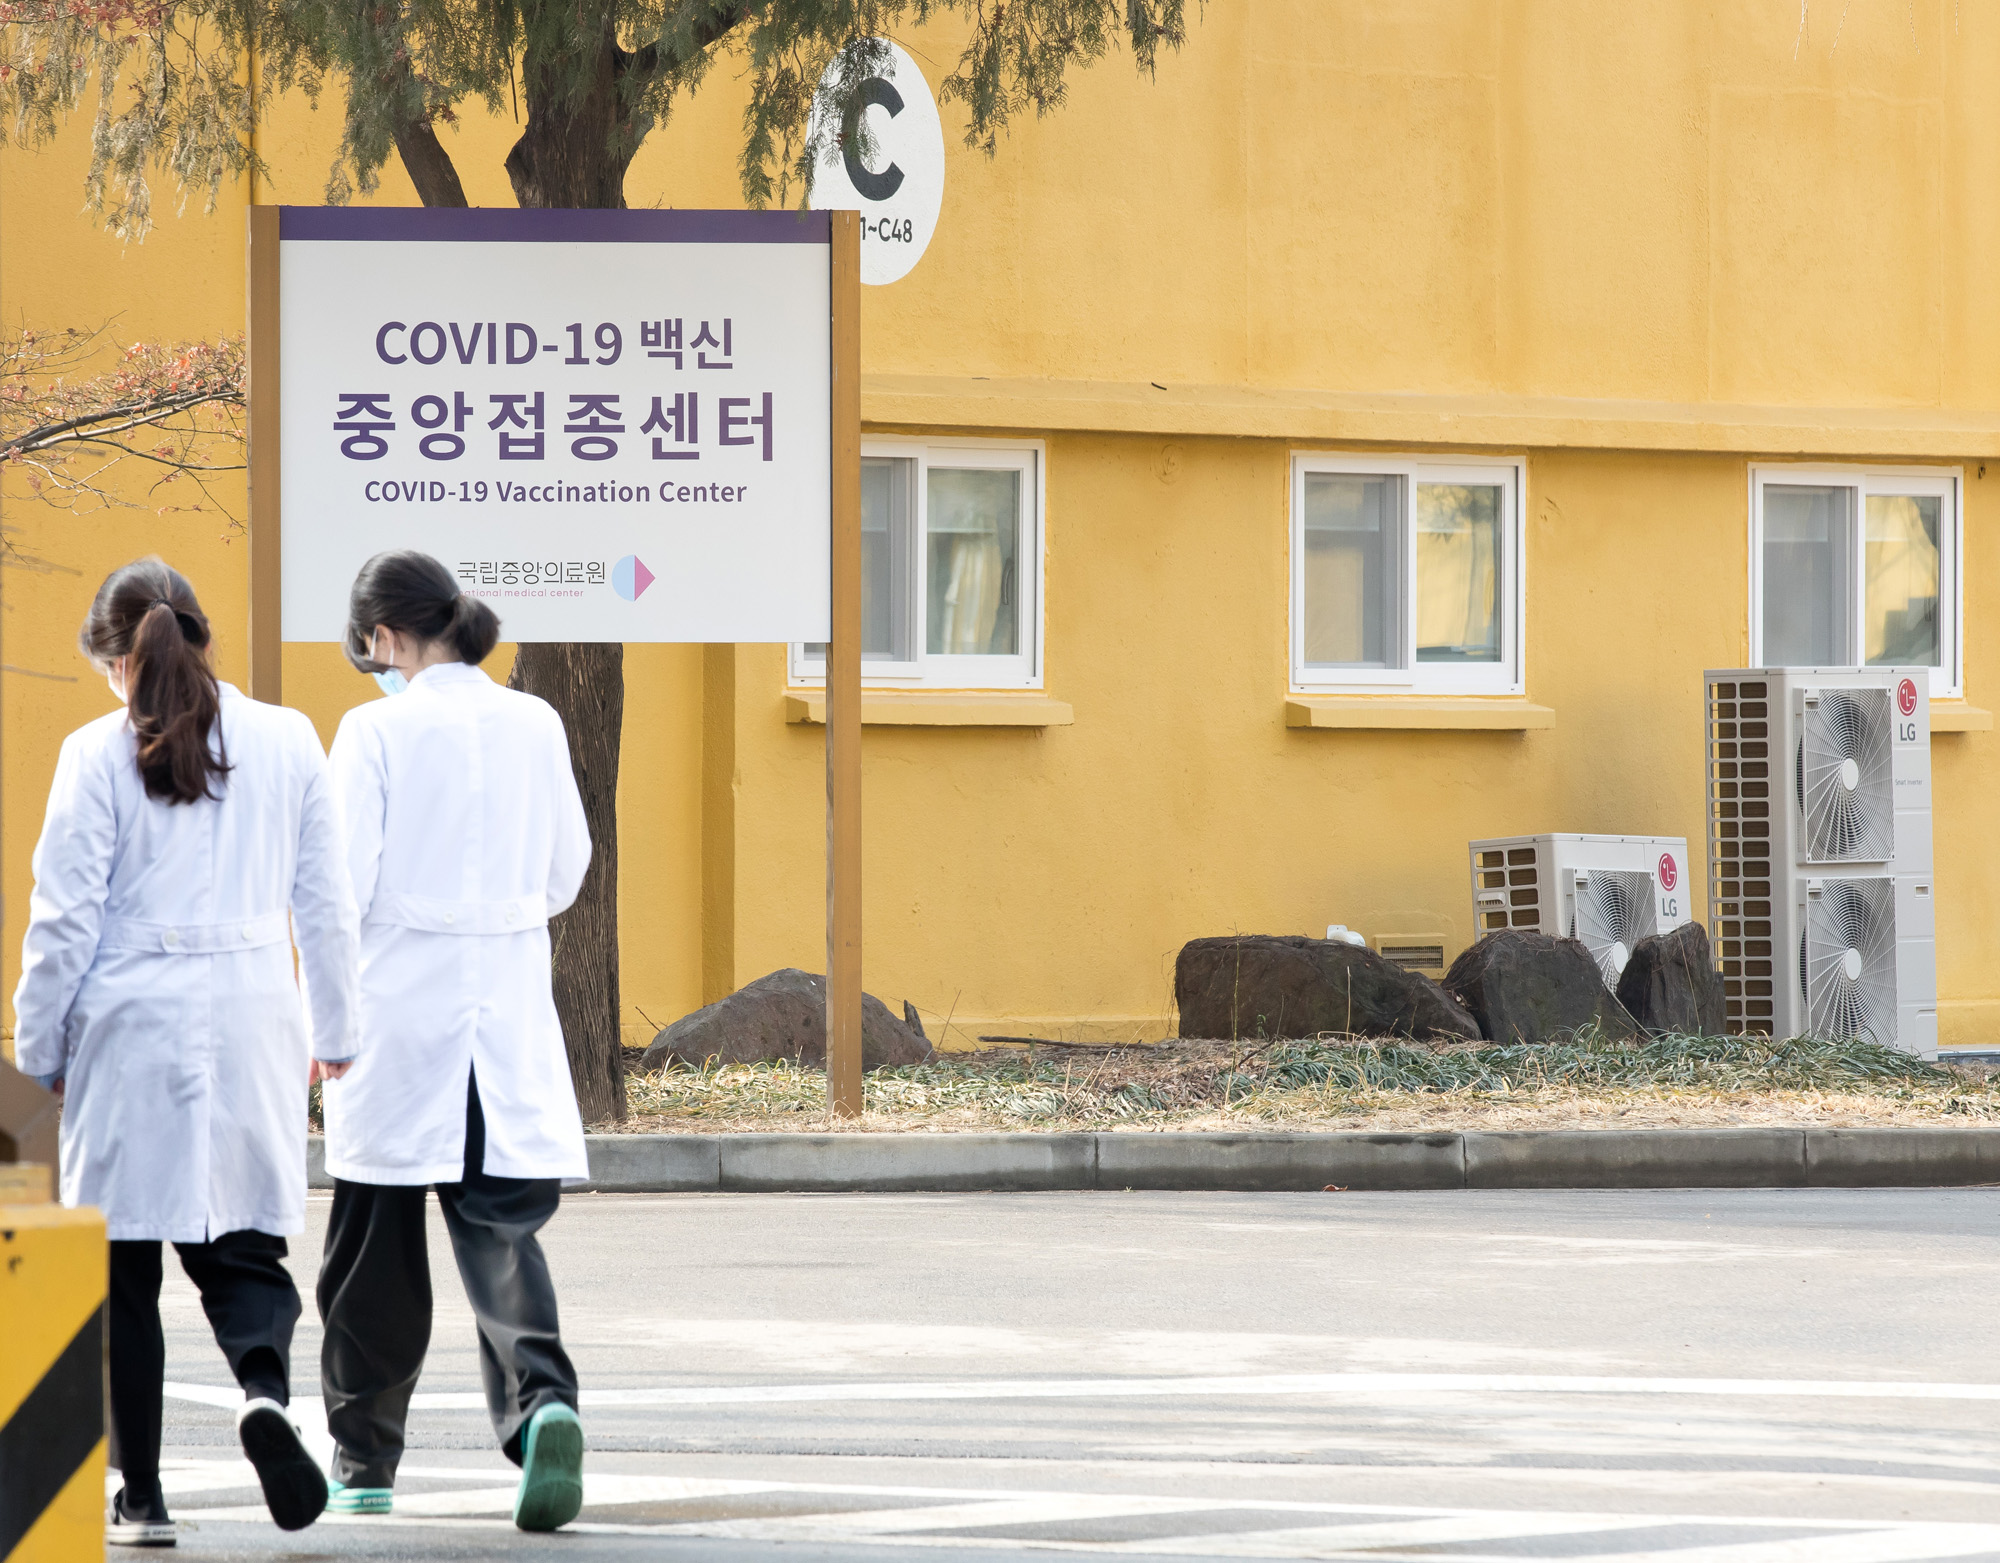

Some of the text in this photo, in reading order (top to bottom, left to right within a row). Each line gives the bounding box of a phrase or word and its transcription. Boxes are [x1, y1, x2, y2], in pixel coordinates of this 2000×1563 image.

[842, 77, 905, 202] C
[375, 317, 733, 370] COVID-19 백신
[333, 390, 773, 462] 중앙접종센터
[364, 479, 748, 503] COVID-19 Vaccination Center
[457, 561, 605, 585] 국립중앙의료원
[504, 588, 547, 598] medical
[549, 589, 585, 598] center
[1899, 722, 1916, 742] LG
[1662, 897, 1678, 917] LG
